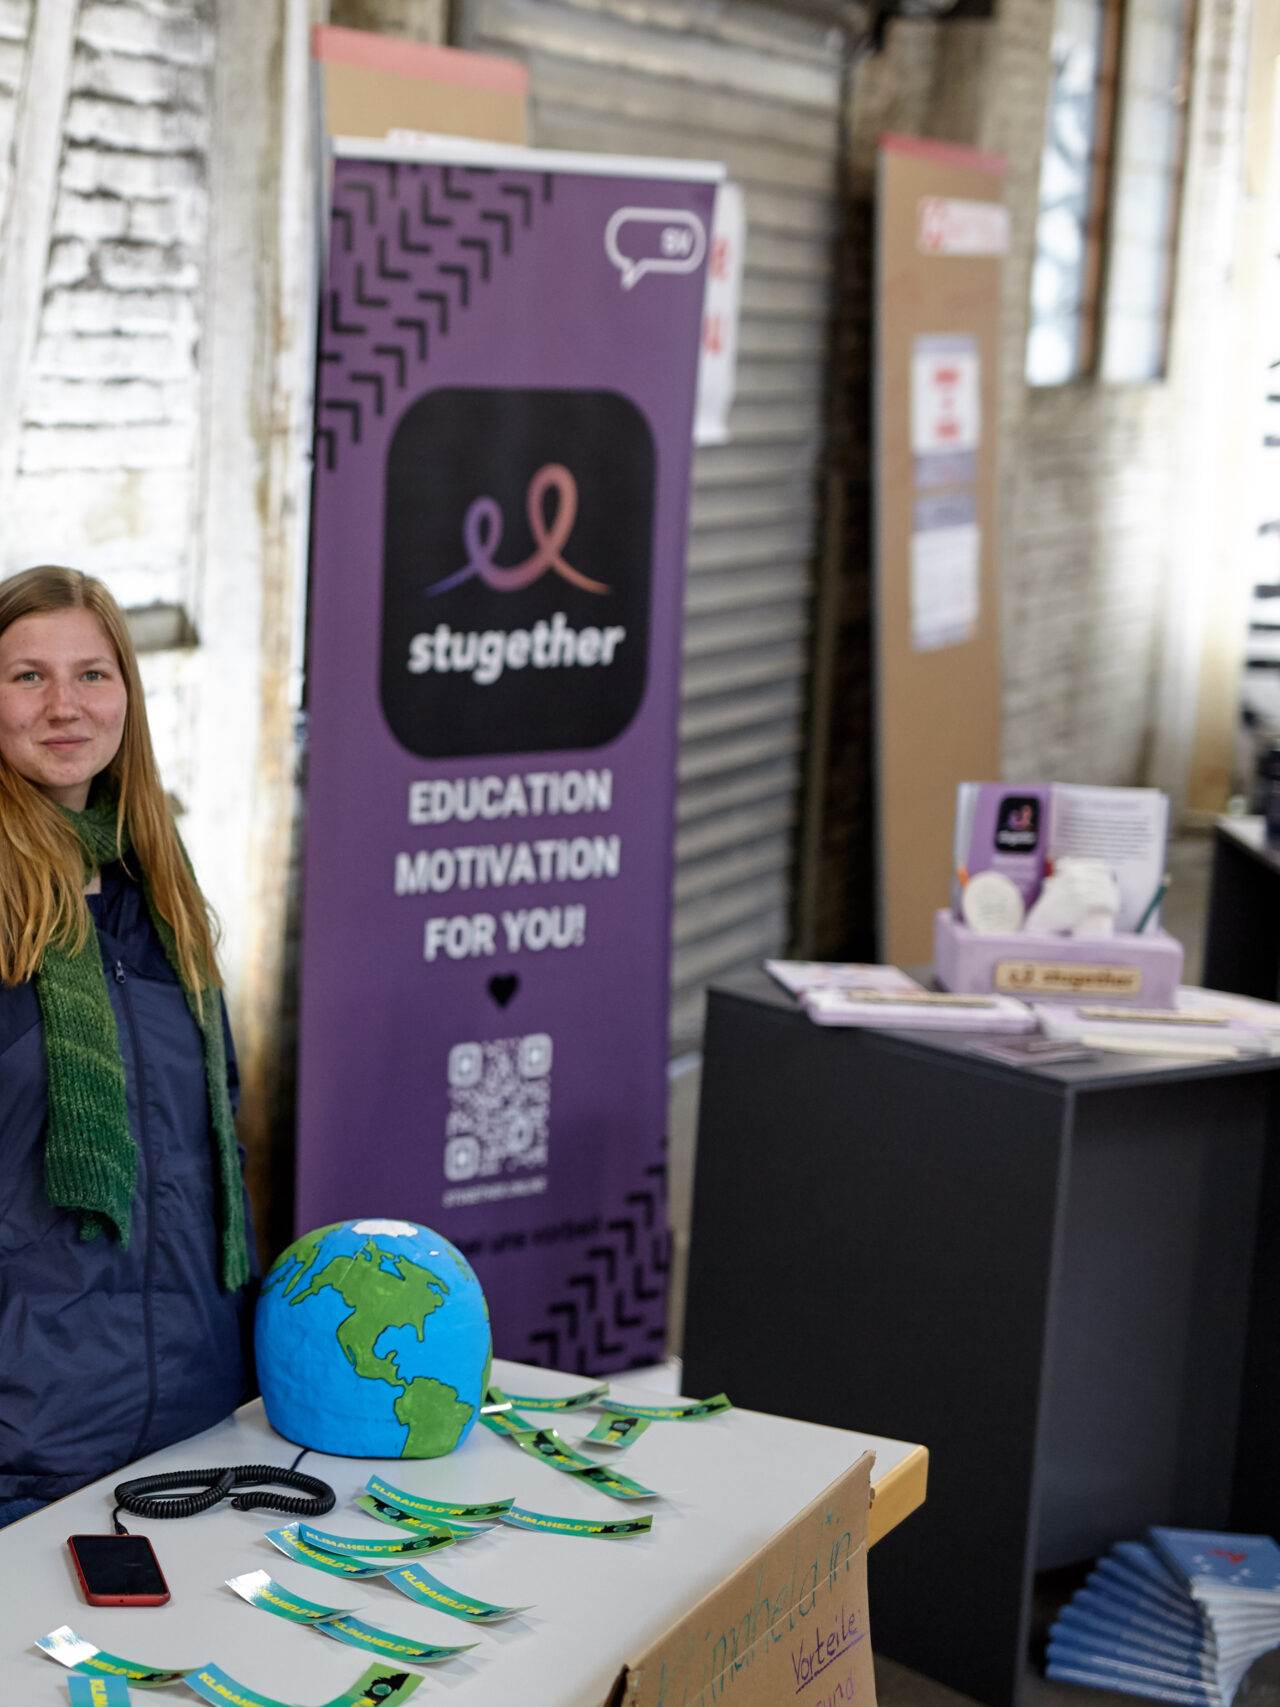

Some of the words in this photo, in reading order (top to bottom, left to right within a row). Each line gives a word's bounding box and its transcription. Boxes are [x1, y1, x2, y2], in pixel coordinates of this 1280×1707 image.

[407, 611, 626, 686] stugether
[408, 768, 613, 826] EDUCATION
[394, 834, 621, 897] MOTIVATION
[423, 912, 497, 962] FOR
[501, 903, 587, 953] YOU!
